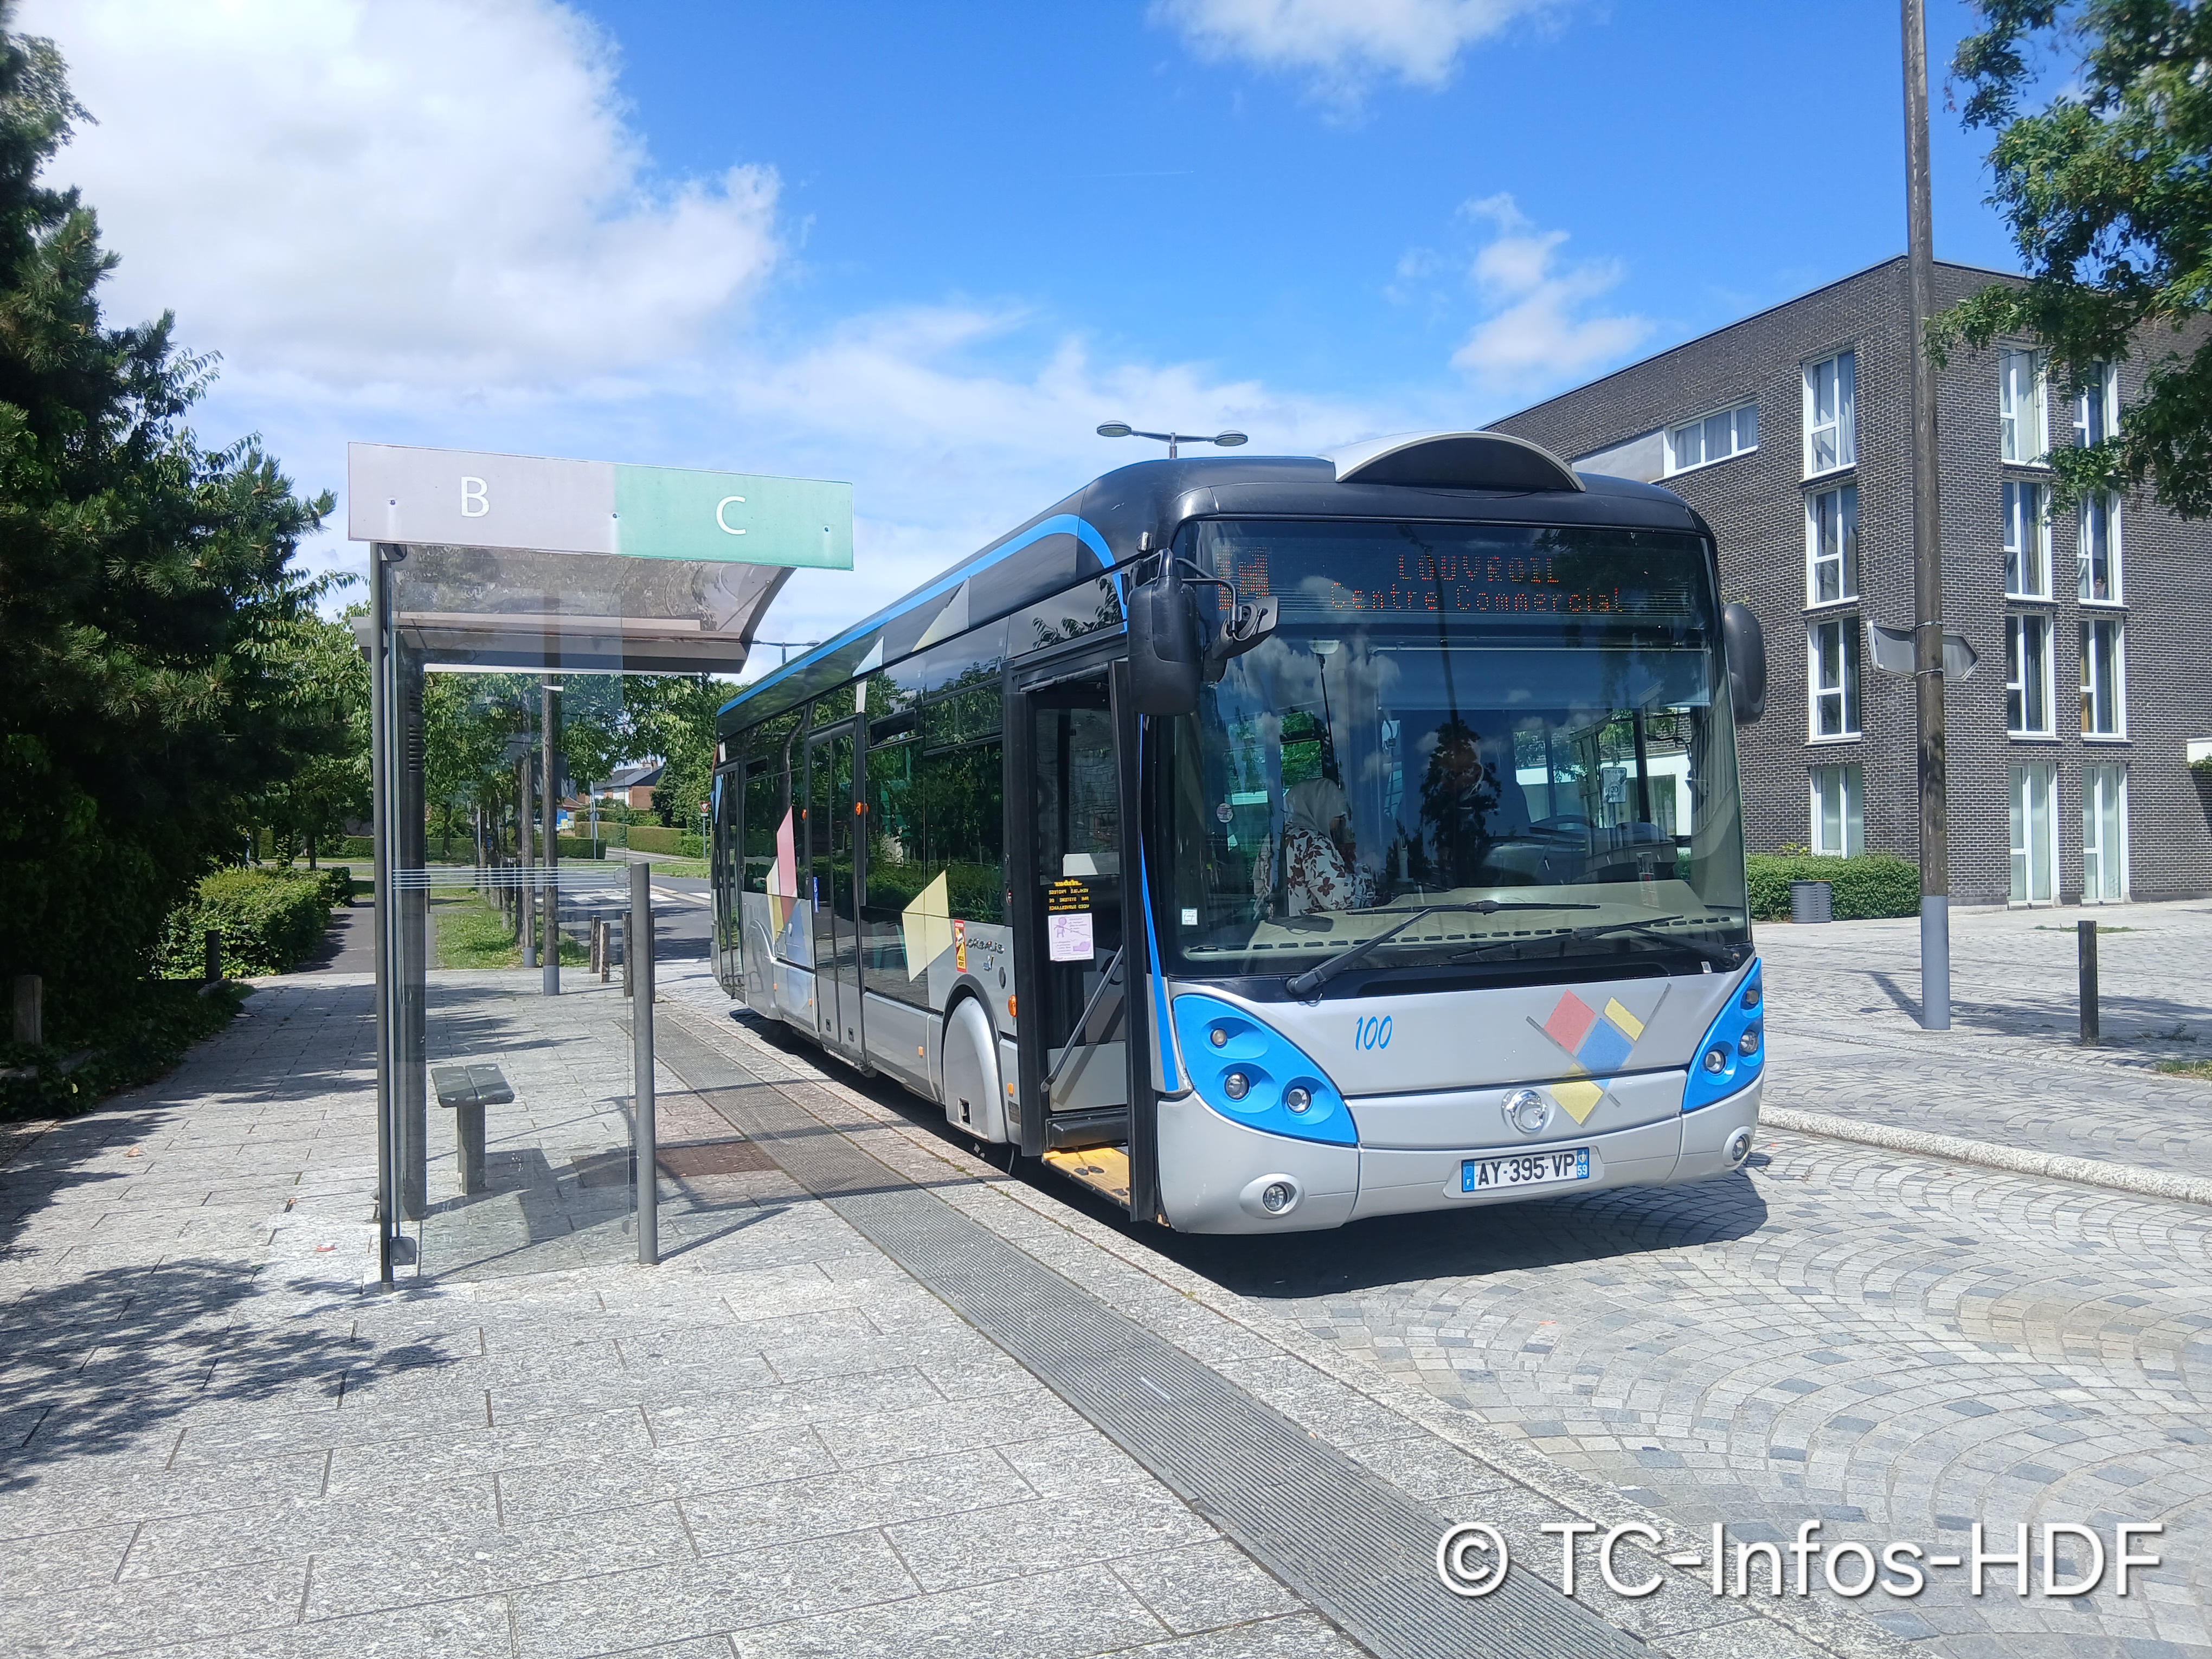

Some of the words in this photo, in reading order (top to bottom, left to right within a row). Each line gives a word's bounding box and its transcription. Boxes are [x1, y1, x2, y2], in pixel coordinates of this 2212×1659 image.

[461, 476, 490, 517] B
[716, 496, 747, 535] C
[1398, 554, 1560, 583] LOUVROIL
[1330, 583, 1439, 609] Centre
[1456, 585, 1623, 612] Commercial
[1355, 1015, 1392, 1051] 100
[1478, 1153, 1575, 1186] AY-395-VP
[1577, 1164, 1588, 1176] 59
